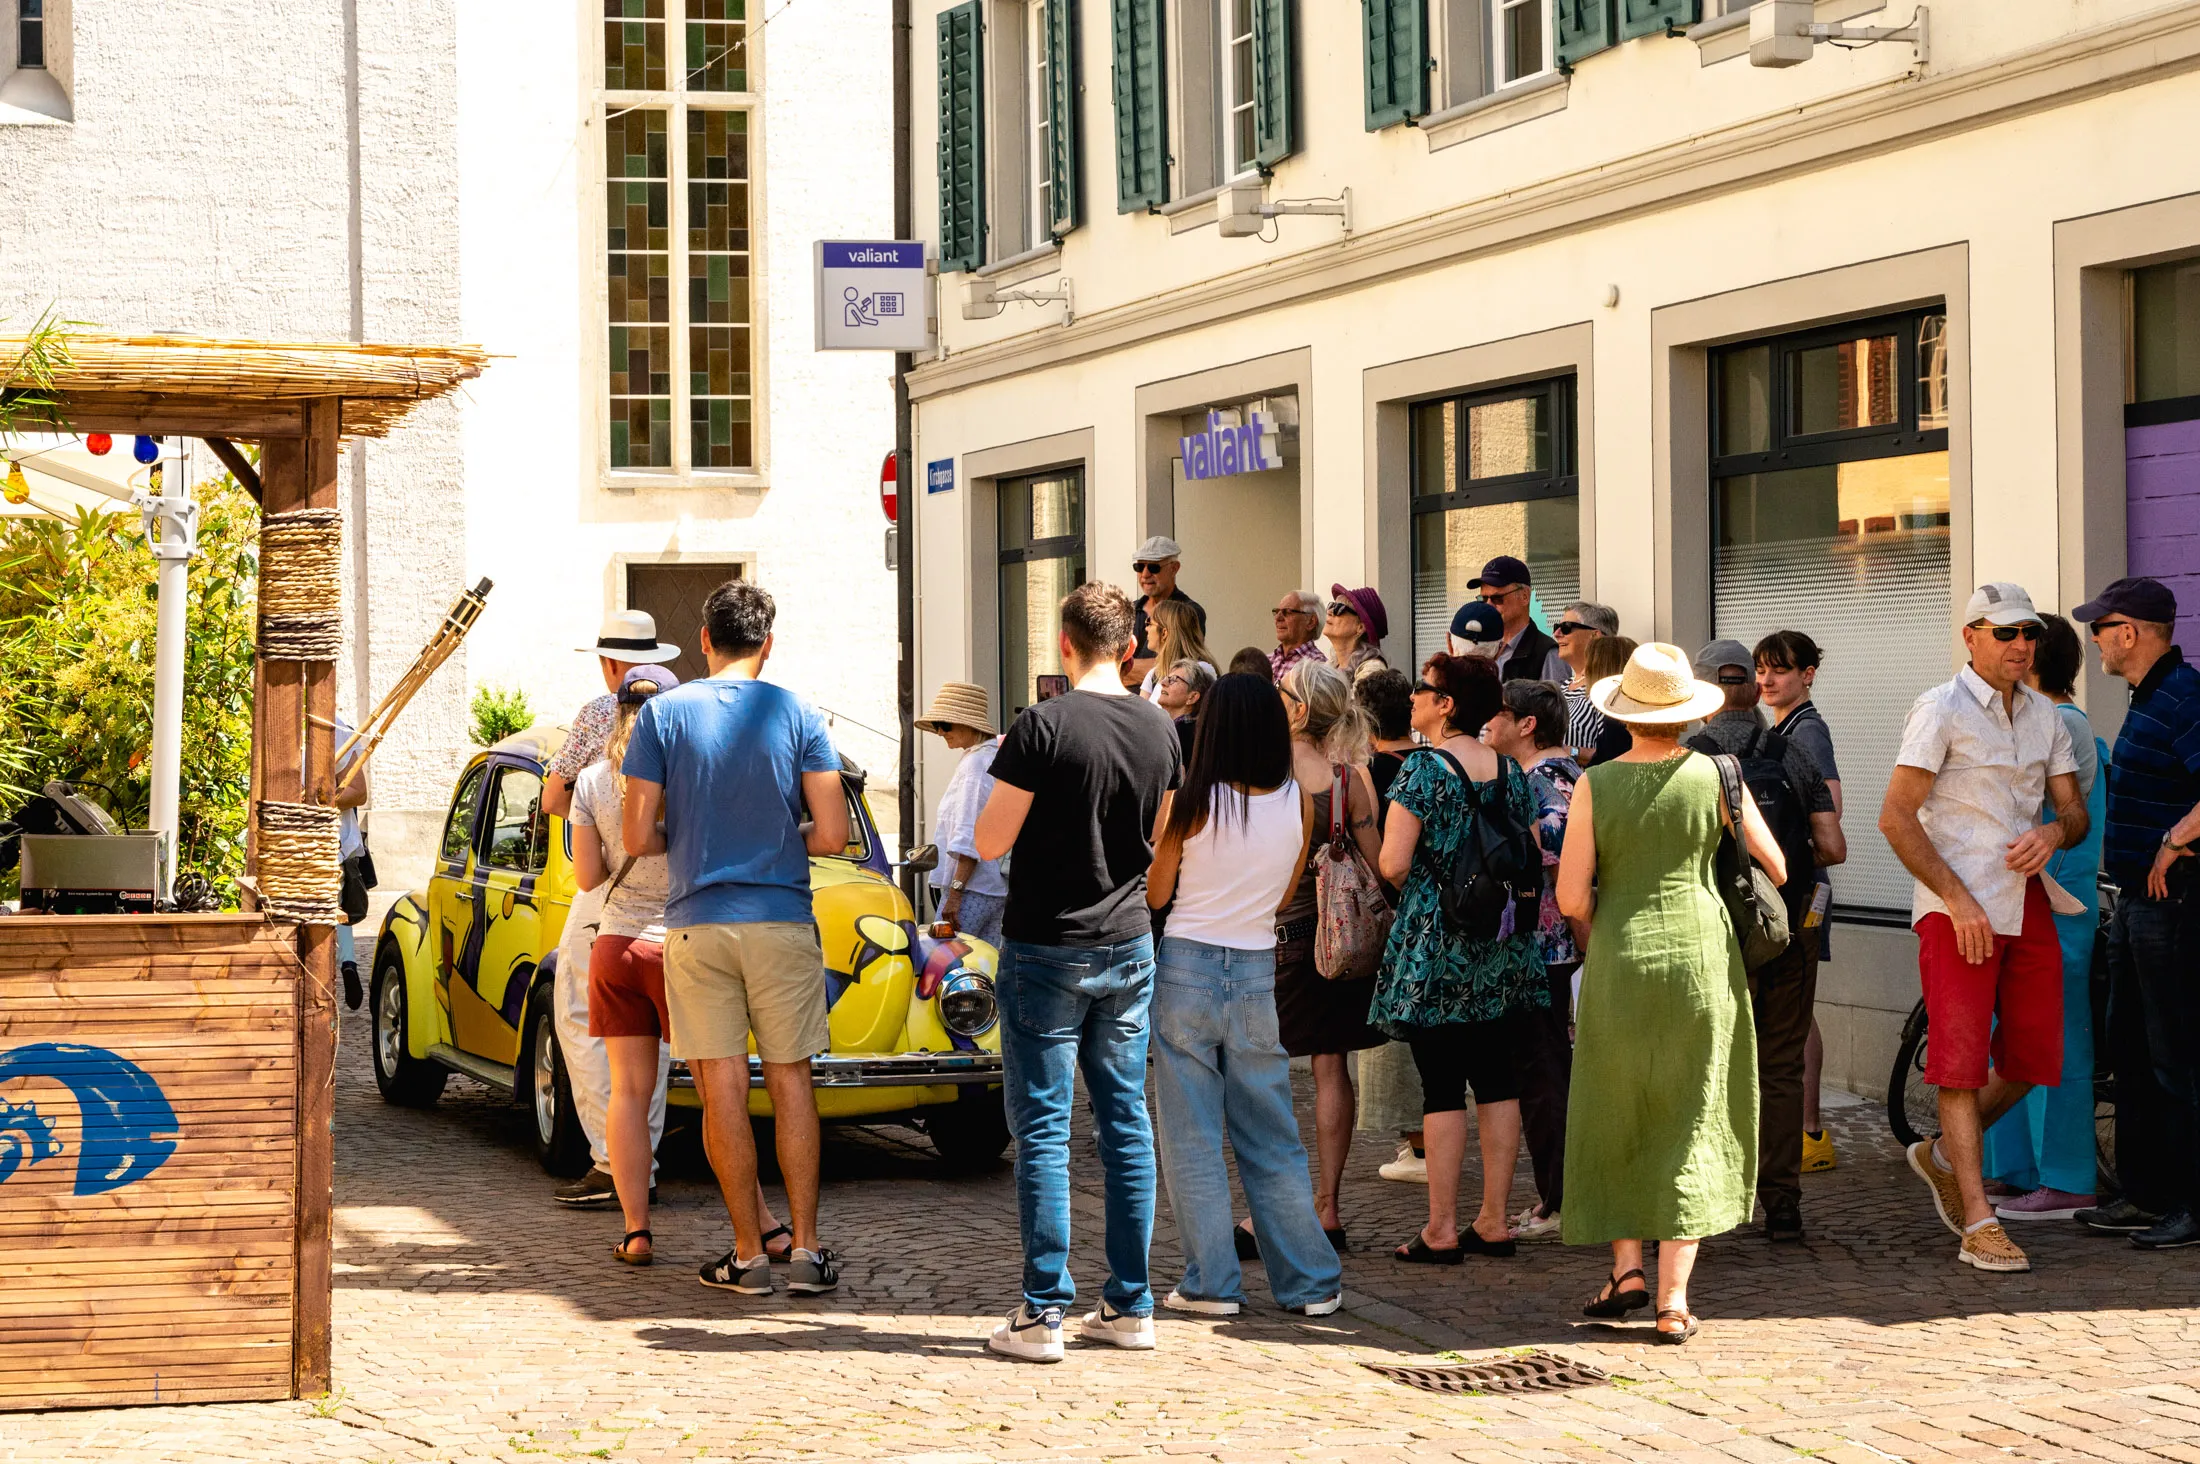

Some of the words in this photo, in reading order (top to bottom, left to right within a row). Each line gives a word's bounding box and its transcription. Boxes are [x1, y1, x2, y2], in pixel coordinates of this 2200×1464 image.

[848, 248, 899, 263] valiant
[1179, 410, 1268, 480] valiant
[929, 467, 952, 488] Kirchgasse
[715, 1264, 730, 1282] N
[1045, 1313, 1061, 1324] NIKE
